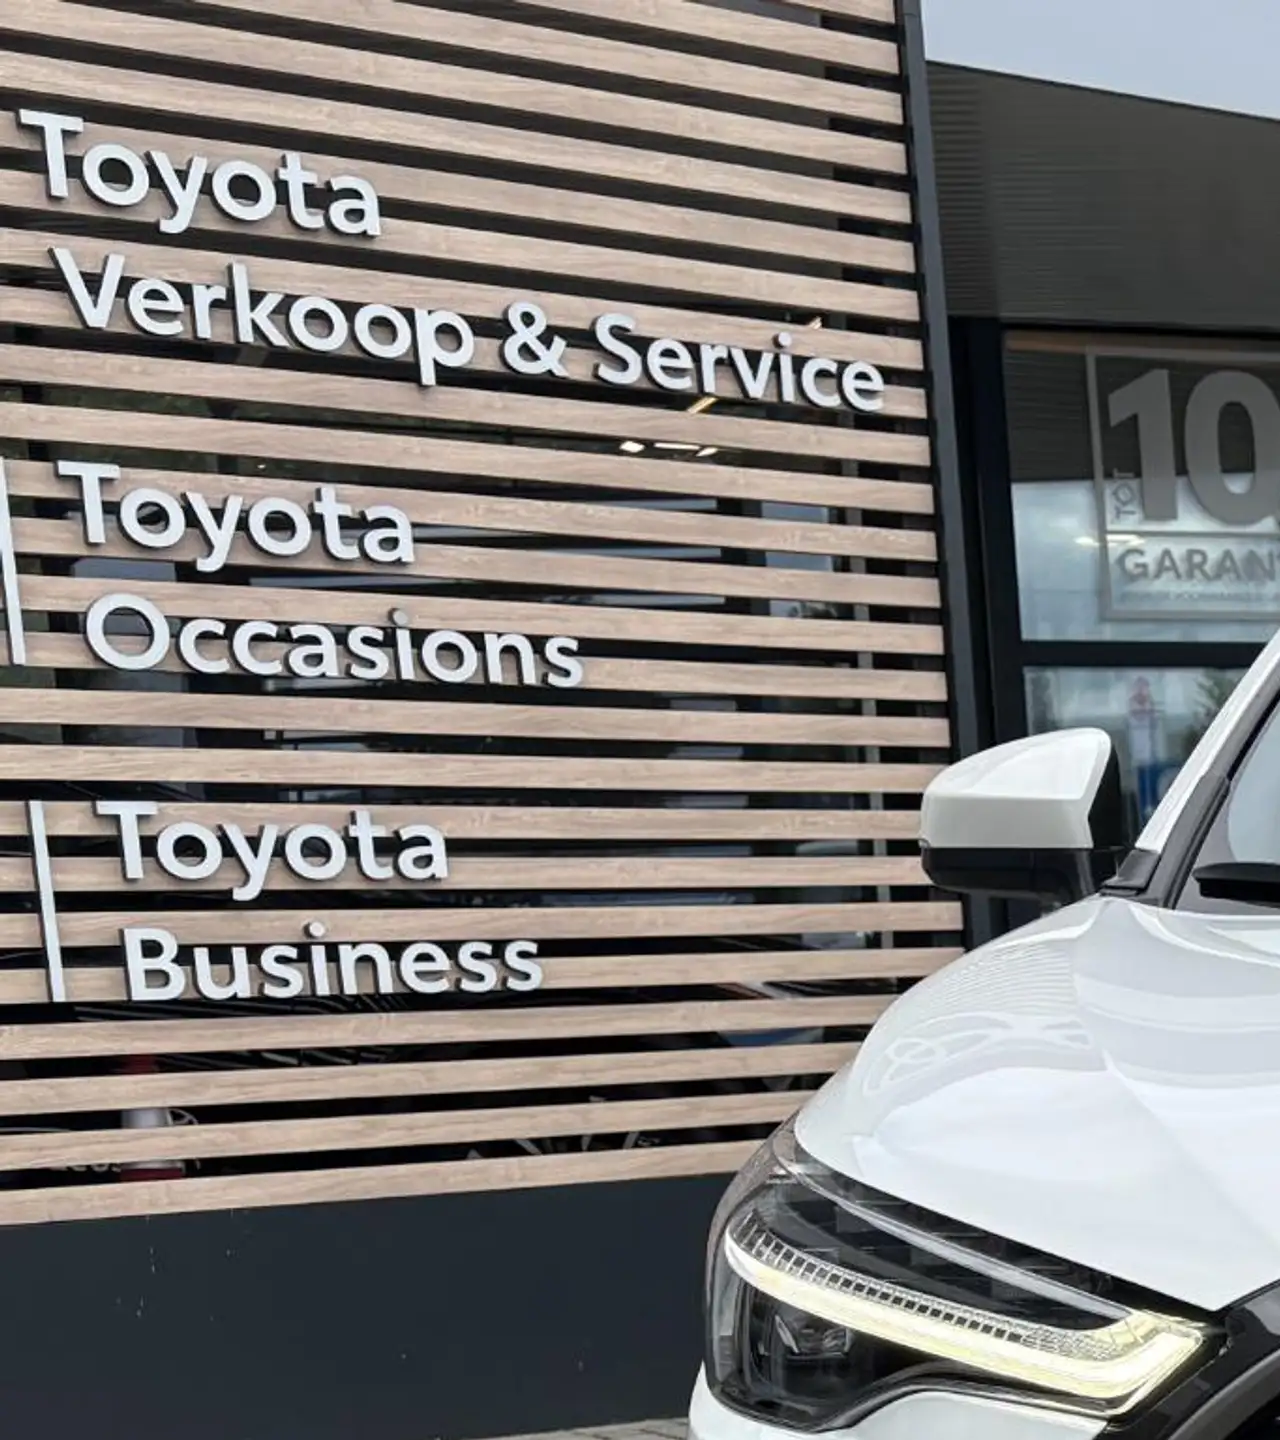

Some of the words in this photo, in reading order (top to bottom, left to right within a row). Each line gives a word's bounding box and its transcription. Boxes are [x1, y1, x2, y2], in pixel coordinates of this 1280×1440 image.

[18, 108, 382, 237] Toyota
[48, 246, 475, 387] Verkoop
[502, 301, 568, 378] &
[596, 312, 887, 412] Service
[57, 460, 416, 573] Toyota
[84, 594, 585, 689] Occasions
[95, 801, 450, 902] Toyota
[121, 921, 544, 1003] Business
